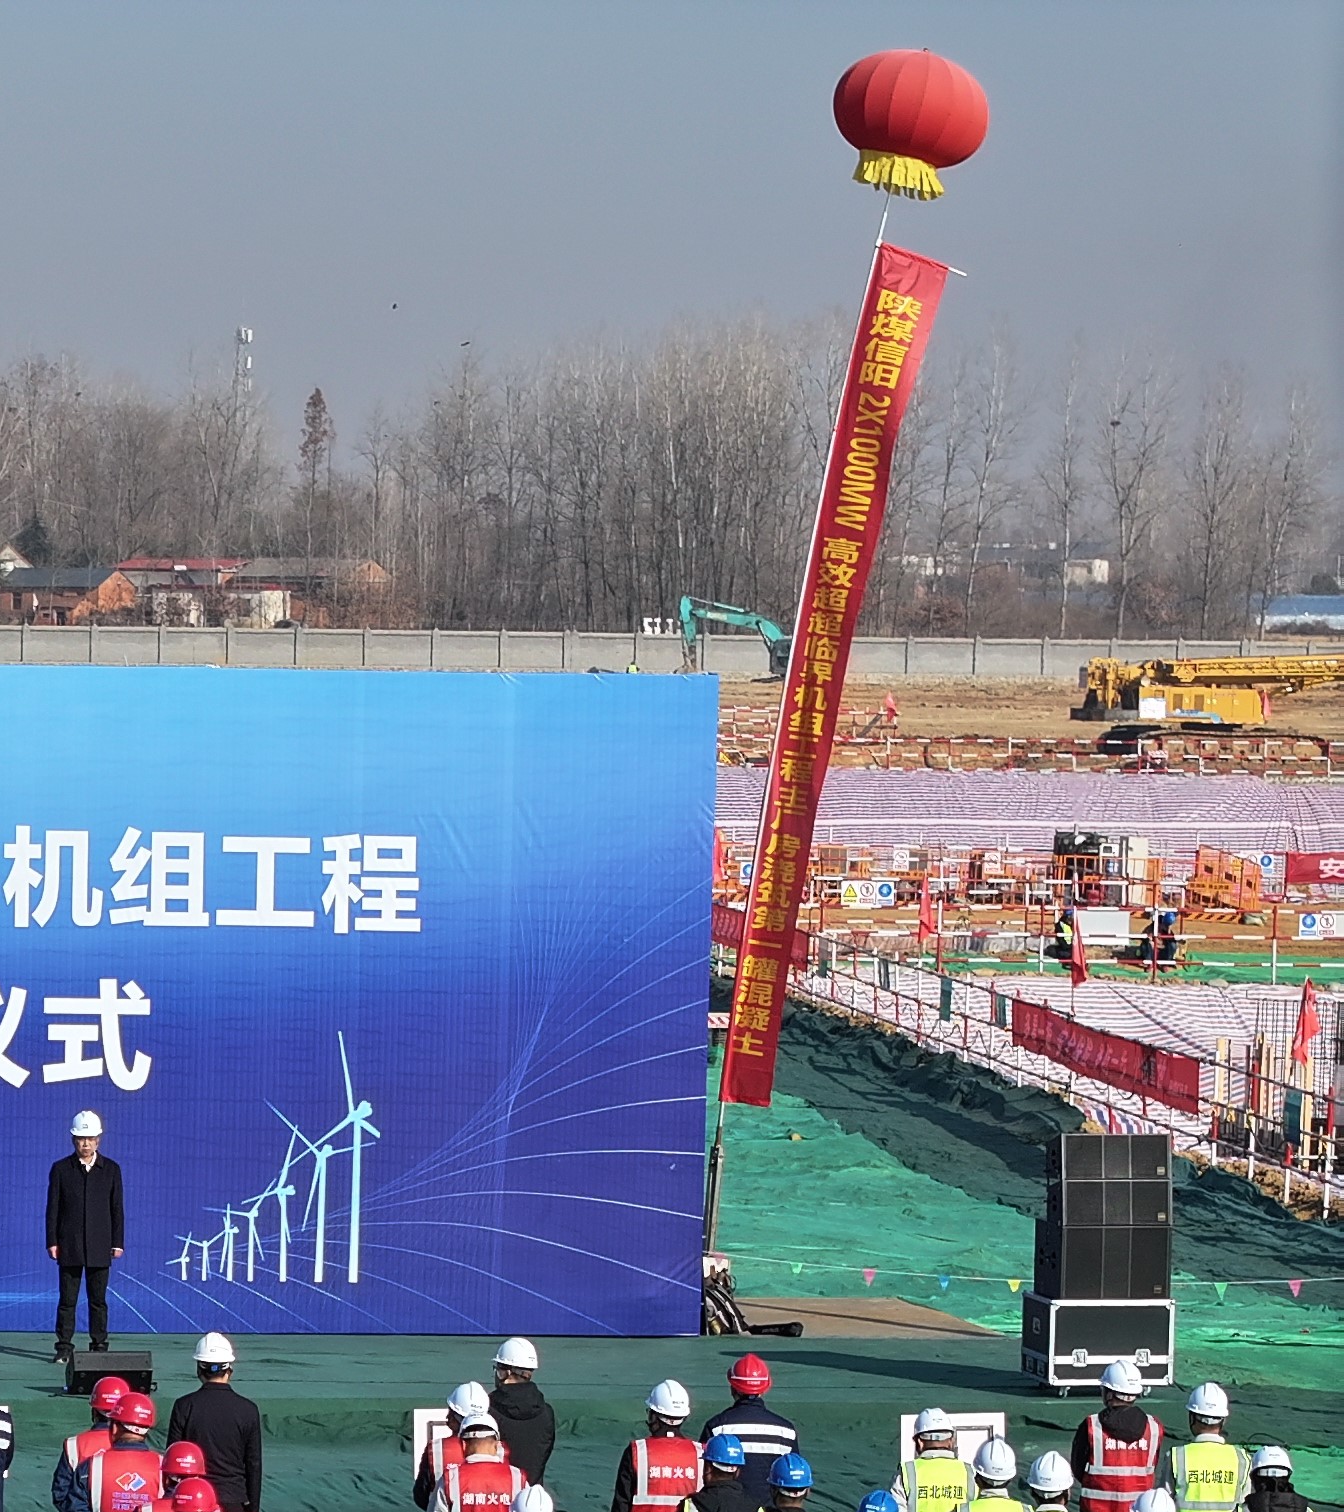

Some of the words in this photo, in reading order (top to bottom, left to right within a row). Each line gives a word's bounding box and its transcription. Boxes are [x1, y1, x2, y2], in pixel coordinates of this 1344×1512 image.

[859, 288, 923, 390] 陕煤信阳
[834, 390, 892, 532] 2X1000MW
[649, 1465, 696, 1479] 湖南火电
[1188, 1469, 1234, 1484] 西北城建
[462, 1492, 511, 1505] 湖南火电
